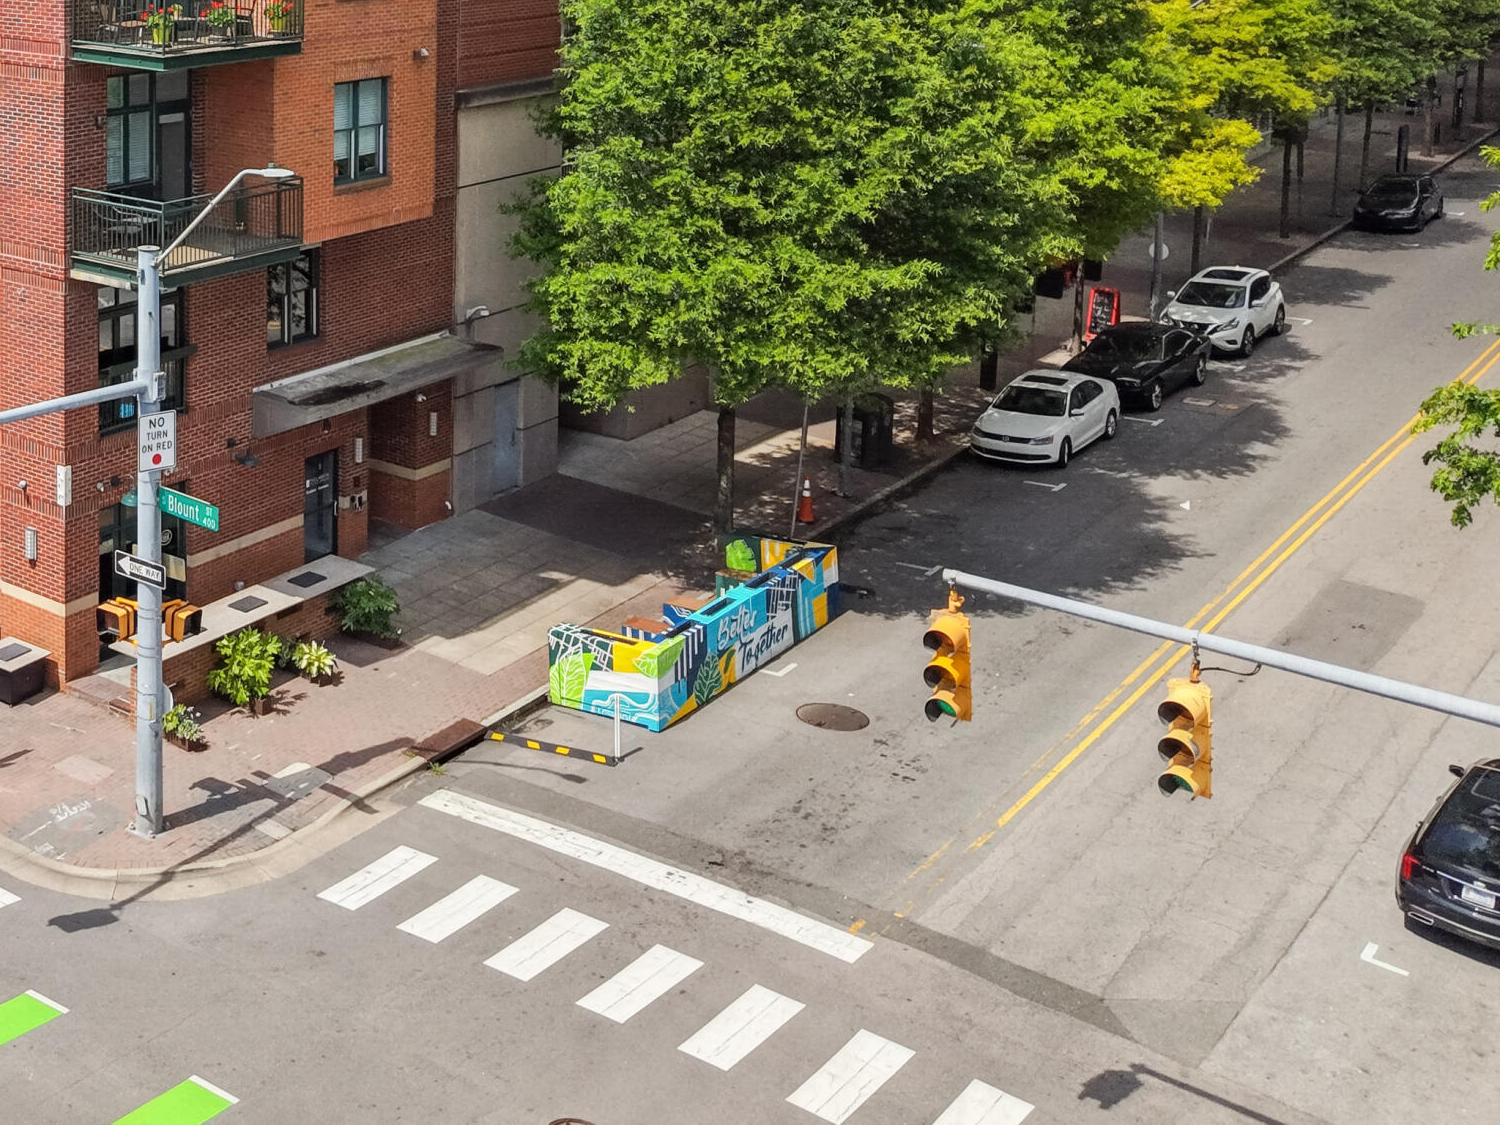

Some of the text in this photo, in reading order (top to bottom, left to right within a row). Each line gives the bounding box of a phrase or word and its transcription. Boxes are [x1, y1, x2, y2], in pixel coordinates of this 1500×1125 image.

[149, 417, 165, 429] NO
[146, 429, 168, 440] TURN
[142, 440, 173, 454] ON RED
[168, 495, 200, 522] Blount
[205, 506, 213, 518] ST
[130, 562, 160, 581] ONE WAY
[717, 604, 758, 651] Better
[738, 621, 789, 673] Together
